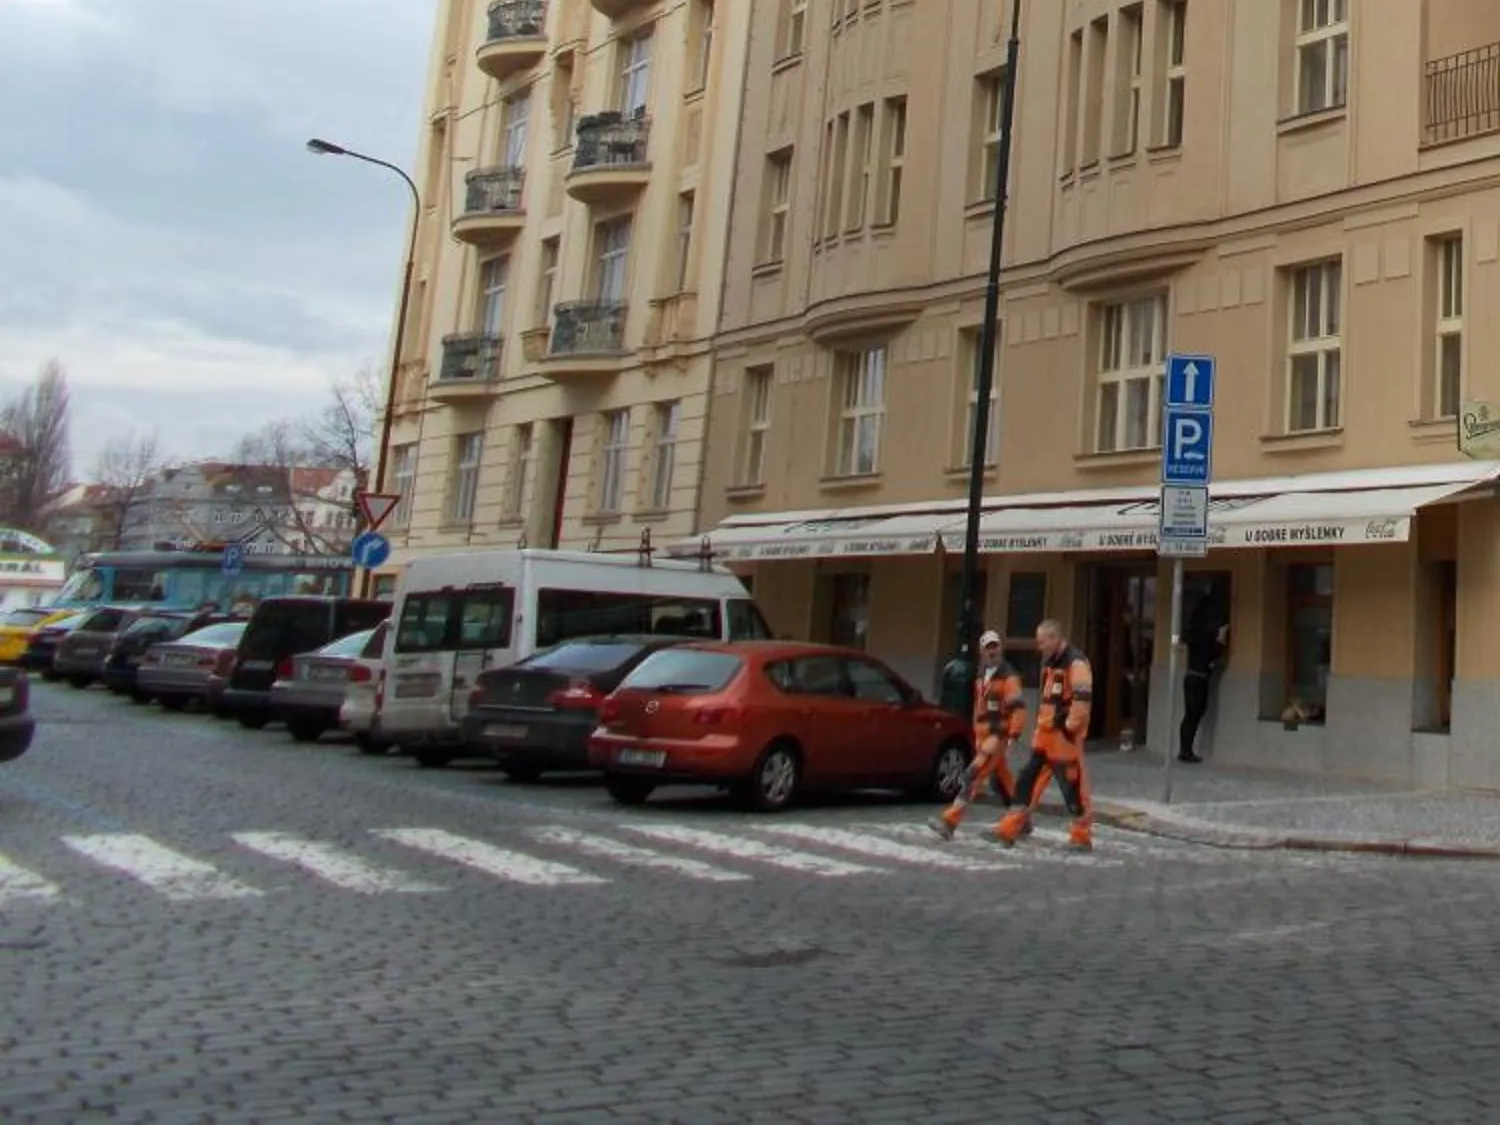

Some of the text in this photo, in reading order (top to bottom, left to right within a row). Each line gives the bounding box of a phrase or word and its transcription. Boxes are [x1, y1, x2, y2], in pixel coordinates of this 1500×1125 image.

[1174, 418, 1202, 460] P
[1245, 530, 1253, 542] U
[1289, 524, 1345, 540] MYŠLENKY
